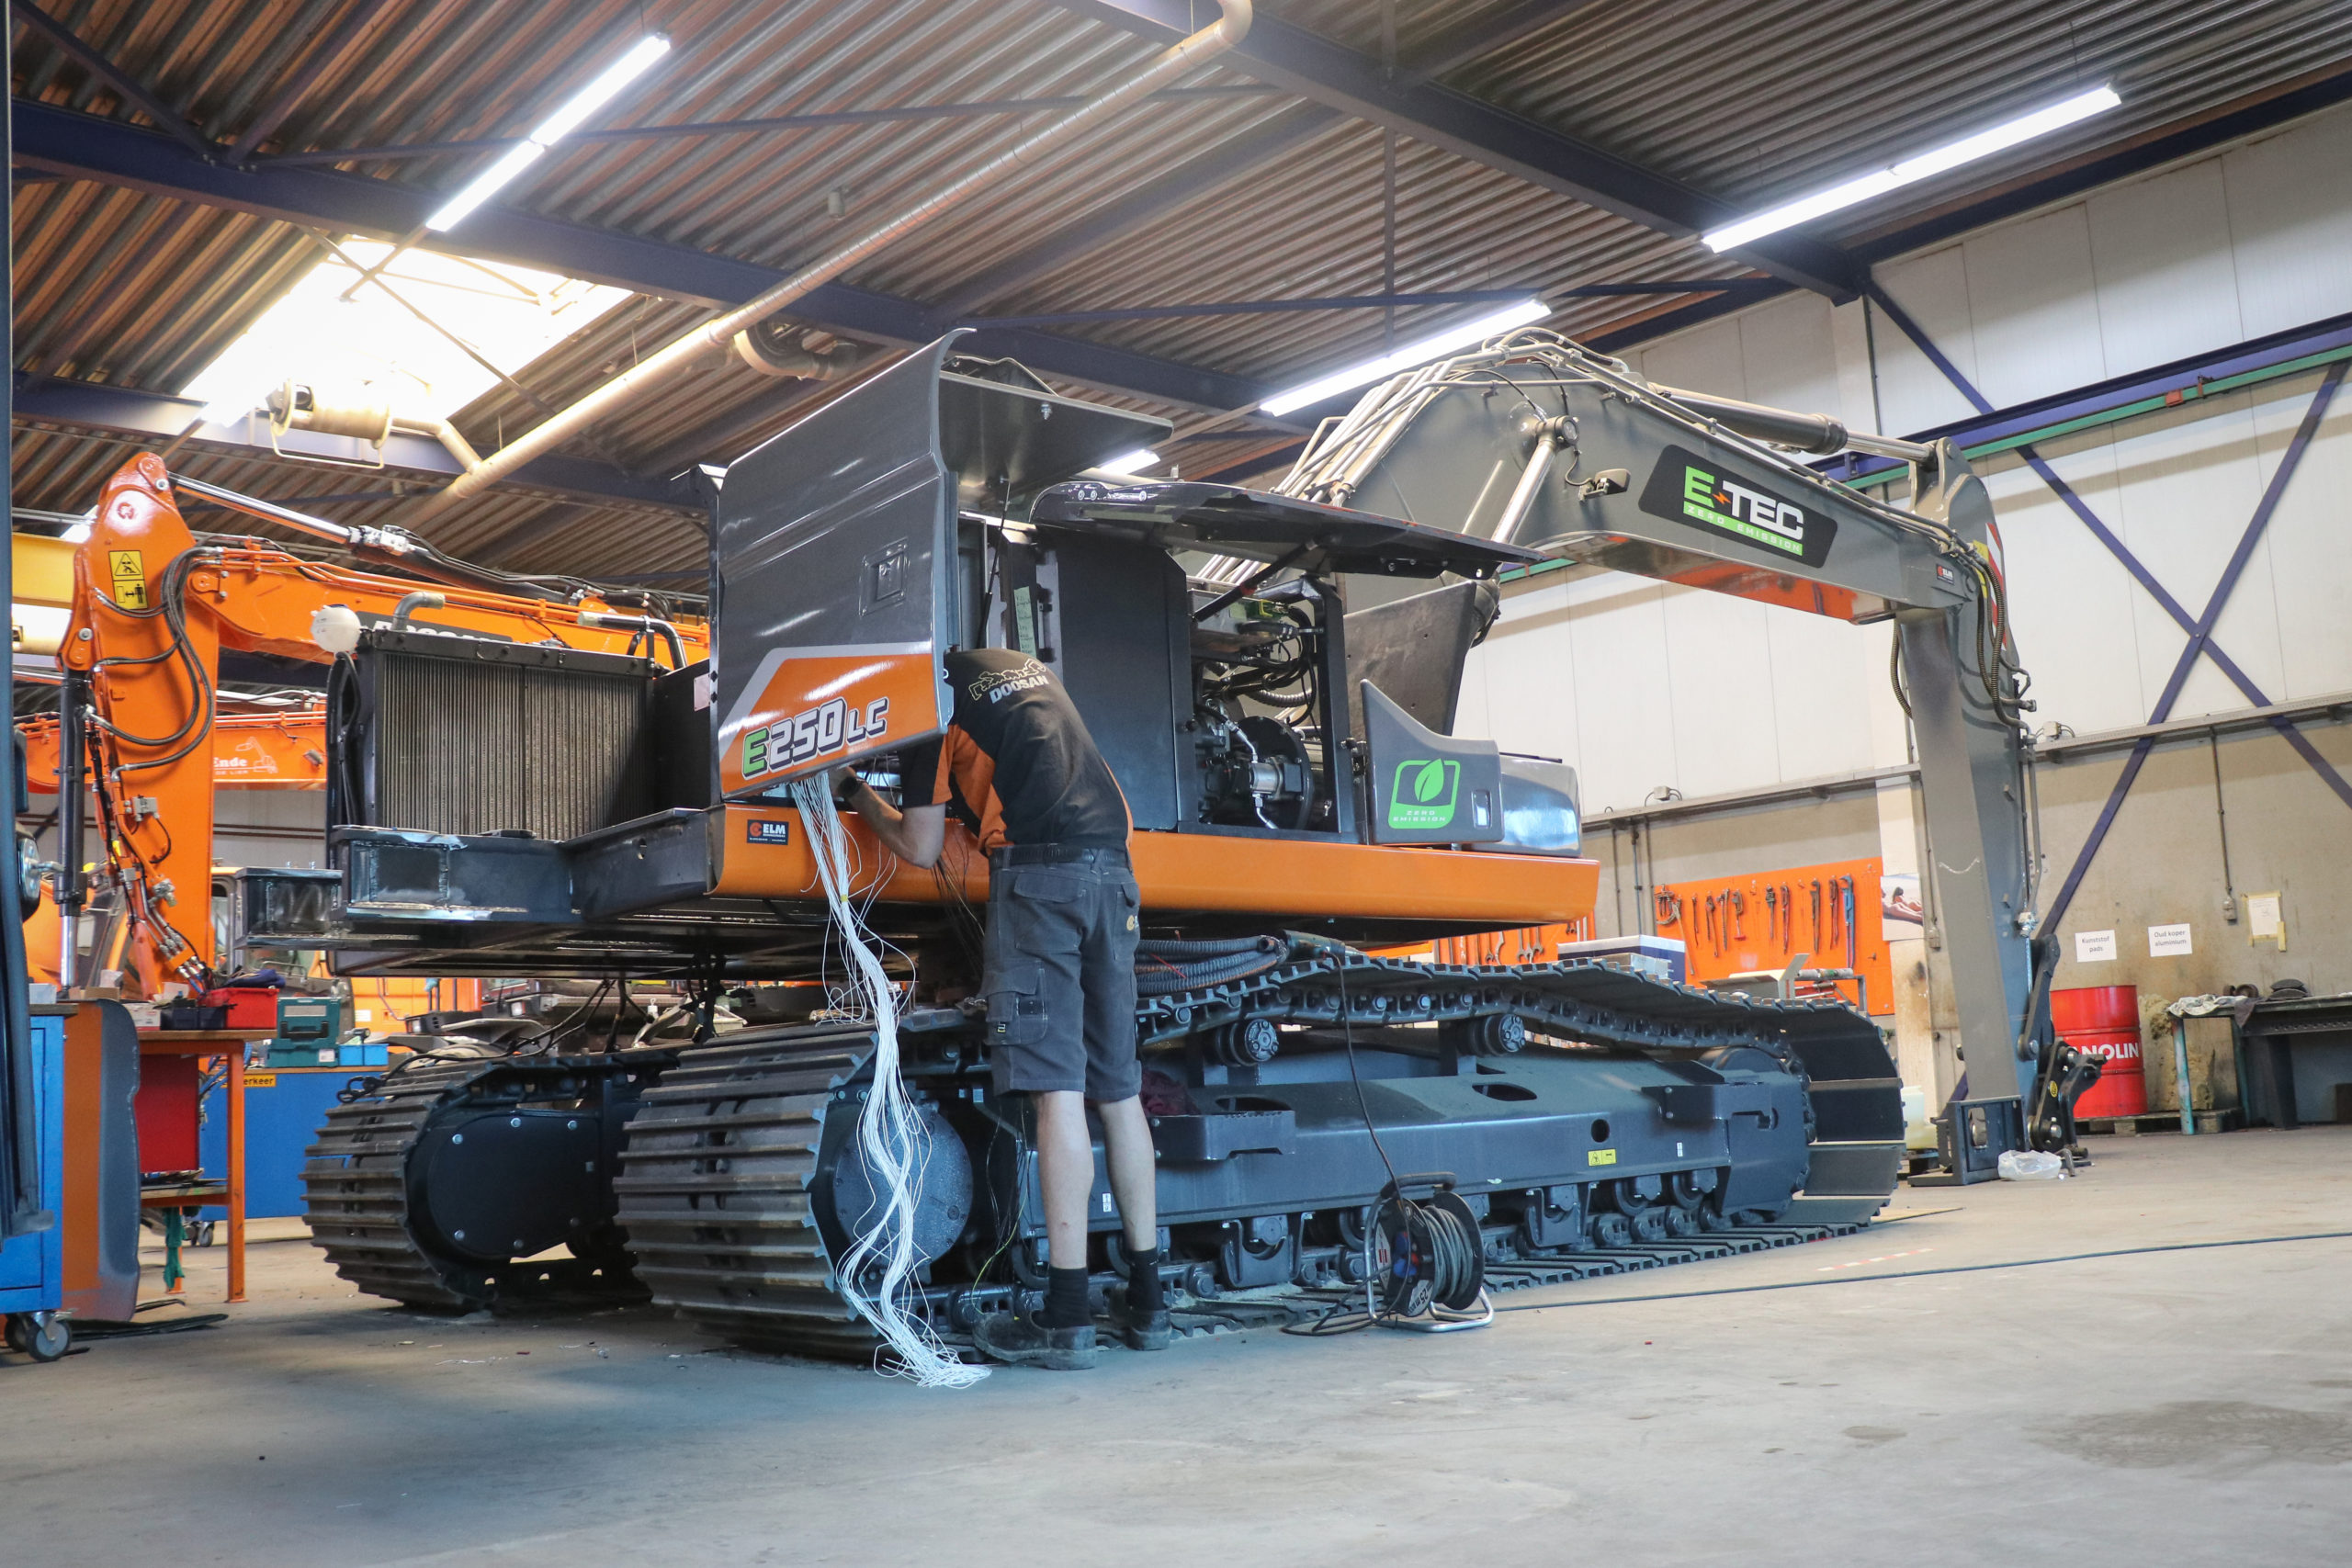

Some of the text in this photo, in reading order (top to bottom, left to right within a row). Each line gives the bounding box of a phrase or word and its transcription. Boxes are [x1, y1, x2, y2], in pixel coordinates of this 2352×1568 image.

[1687, 504, 1800, 552] ZERO EMISSION
[989, 675, 1049, 704] DOOSAN
[763, 823, 786, 834] ELM
[2168, 930, 2186, 938] koper
[2154, 939, 2187, 947] aluminium
[2073, 1043, 2139, 1060] NOLIN
[243, 1077, 274, 1086] erkeer
